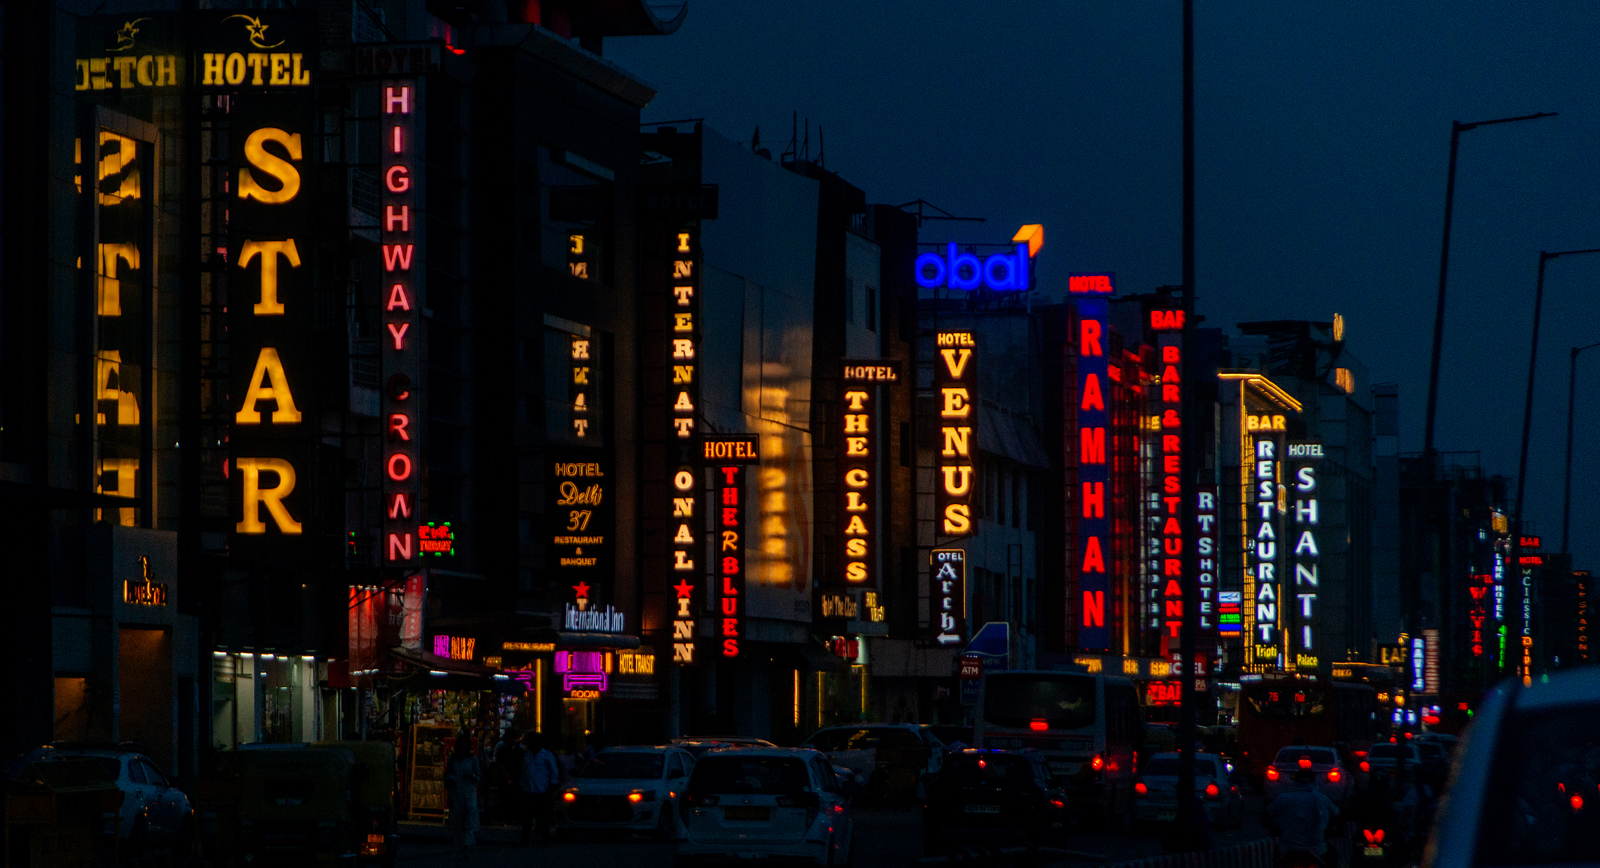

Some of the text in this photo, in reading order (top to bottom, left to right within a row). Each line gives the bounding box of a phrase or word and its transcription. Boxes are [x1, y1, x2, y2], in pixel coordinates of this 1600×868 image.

[202, 52, 310, 86] HOTEL
[357, 47, 438, 74] HOTEL
[1069, 276, 1112, 292] HOTEL
[235, 126, 302, 534] STAR
[382, 86, 417, 561] HIGHWAY CROWN
[937, 333, 975, 346] HOTEL
[844, 365, 897, 381] HOTEL
[1247, 414, 1286, 432] BAR
[704, 441, 756, 459] HOTEL
[940, 349, 973, 534] VENUS
[1287, 444, 1324, 456] HOTEL
[555, 463, 603, 476] HOTEL
[1080, 319, 1108, 627] RAMHAN
[557, 481, 602, 505] Delhi
[844, 391, 869, 581] THE CLASS
[1162, 346, 1183, 638] BAR & RESTAURANT
[567, 510, 591, 530] 37
[554, 536, 604, 545] RESTAURANT
[1257, 440, 1276, 643] RESTAURANT
[1520, 537, 1540, 547] BAR
[560, 557, 597, 567] BANQUET
[937, 552, 963, 561] OTEL
[1294, 466, 1319, 649] SHANTI
[1519, 556, 1543, 566] HOTEL
[936, 562, 958, 631] Arch
[1199, 558, 1213, 629] HOTEL
[722, 557, 739, 656] BLUES
[673, 597, 695, 662] INN
[502, 642, 556, 652] RESTAURANT
[1296, 653, 1318, 668] Palace
[961, 666, 979, 675] ATM
[571, 689, 600, 699] ROOM
